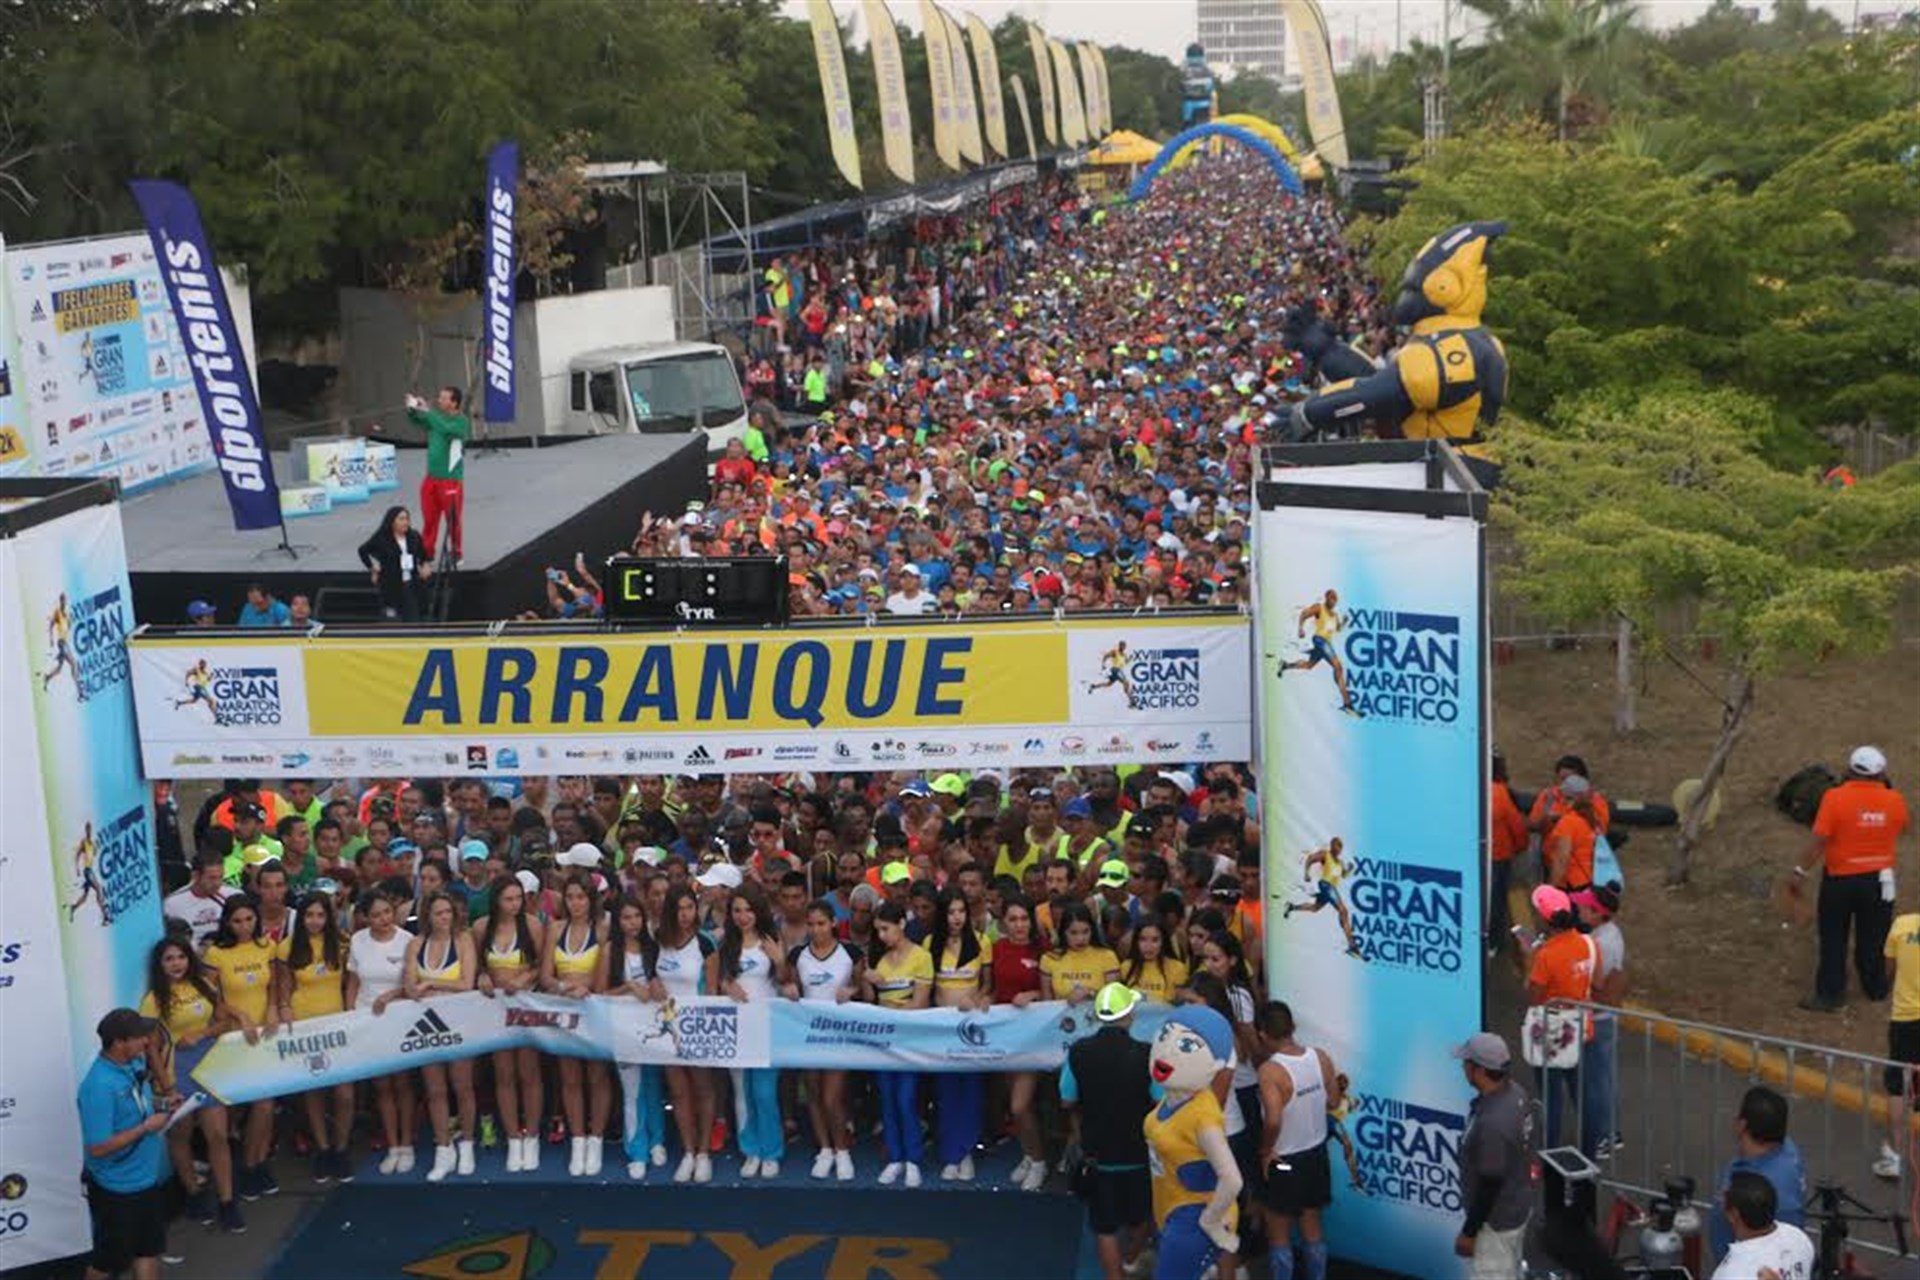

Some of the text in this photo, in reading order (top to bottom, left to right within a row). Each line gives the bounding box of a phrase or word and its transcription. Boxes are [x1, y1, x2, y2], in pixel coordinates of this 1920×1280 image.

[486, 187, 513, 394] dportenis
[165, 241, 266, 491] dportenis
[73, 604, 124, 655] GRAN
[685, 608, 715, 619] TYR
[1348, 608, 1396, 631] XVIII
[1345, 631, 1459, 676] GRAN
[402, 637, 973, 727] ARRANQUE
[1131, 661, 1199, 682] GRAN
[1346, 669, 1459, 698] MARATON
[213, 680, 279, 699] GRAN
[1132, 682, 1199, 694] MARATON
[1132, 694, 1199, 708] PACIFICO
[215, 712, 281, 724] PACIFICO
[216, 700, 281, 711] MARATON
[1347, 691, 1458, 723] PACIFICO
[99, 823, 148, 880] GRAN
[102, 858, 150, 899] MARATON
[1353, 857, 1400, 881] XVIII
[103, 875, 151, 917] PACIFICO
[1350, 879, 1462, 928] GRAN
[1352, 914, 1462, 948] MARATON
[1353, 936, 1461, 972] PACIFICO
[680, 1017, 737, 1035] GRAN
[810, 1016, 896, 1035] dportenis
[277, 1030, 347, 1060] PACIFICO
[400, 1031, 463, 1053] adidas
[1359, 1093, 1405, 1119] XVIII
[1356, 1115, 1462, 1170] GRAN
[1356, 1151, 1463, 1192] MARATON
[1357, 1170, 1462, 1211] PACIFICO
[577, 1229, 951, 1280] TYR
